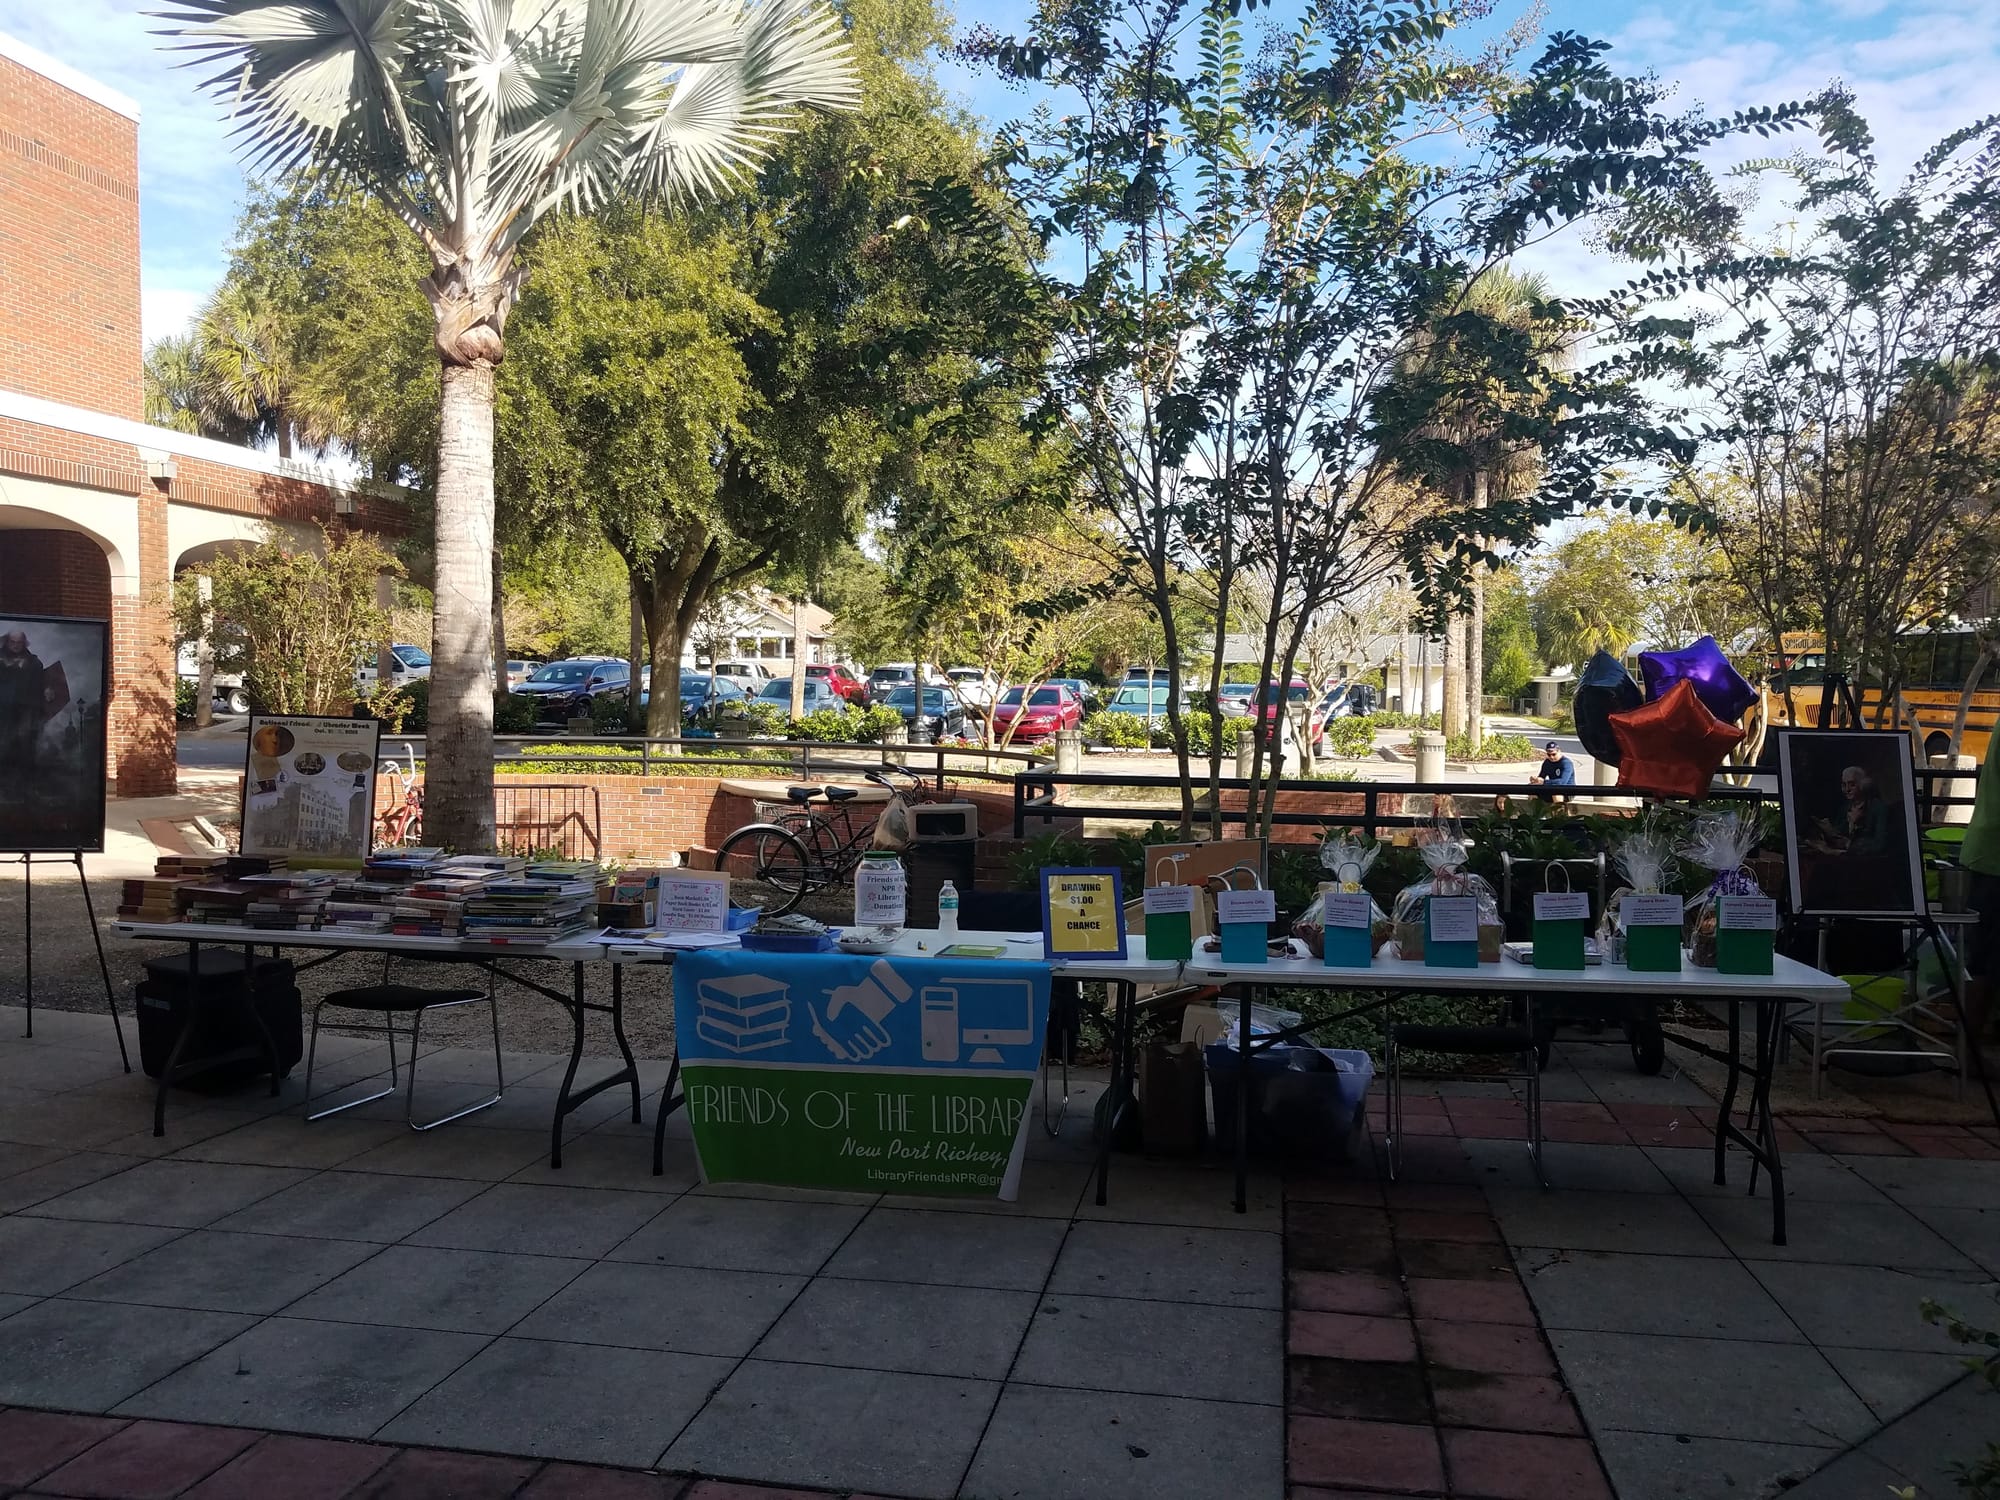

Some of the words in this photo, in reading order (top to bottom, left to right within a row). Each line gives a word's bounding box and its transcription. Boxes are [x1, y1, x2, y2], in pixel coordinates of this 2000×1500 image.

[1785, 638, 1808, 649] SCHOOL
[867, 875, 893, 883] Friends
[1061, 883, 1102, 892] DRAWING
[878, 894, 900, 902] Library
[1070, 895, 1094, 904] $1.00
[1079, 908, 1086, 917] A
[1067, 921, 1101, 930] CHANCE
[690, 1085, 789, 1126] FRIENDS
[804, 1090, 857, 1129] OF
[874, 1093, 917, 1133] THE
[840, 1136, 881, 1157] New
[887, 1138, 931, 1161] Port
[935, 1141, 1008, 1169] Richey,
